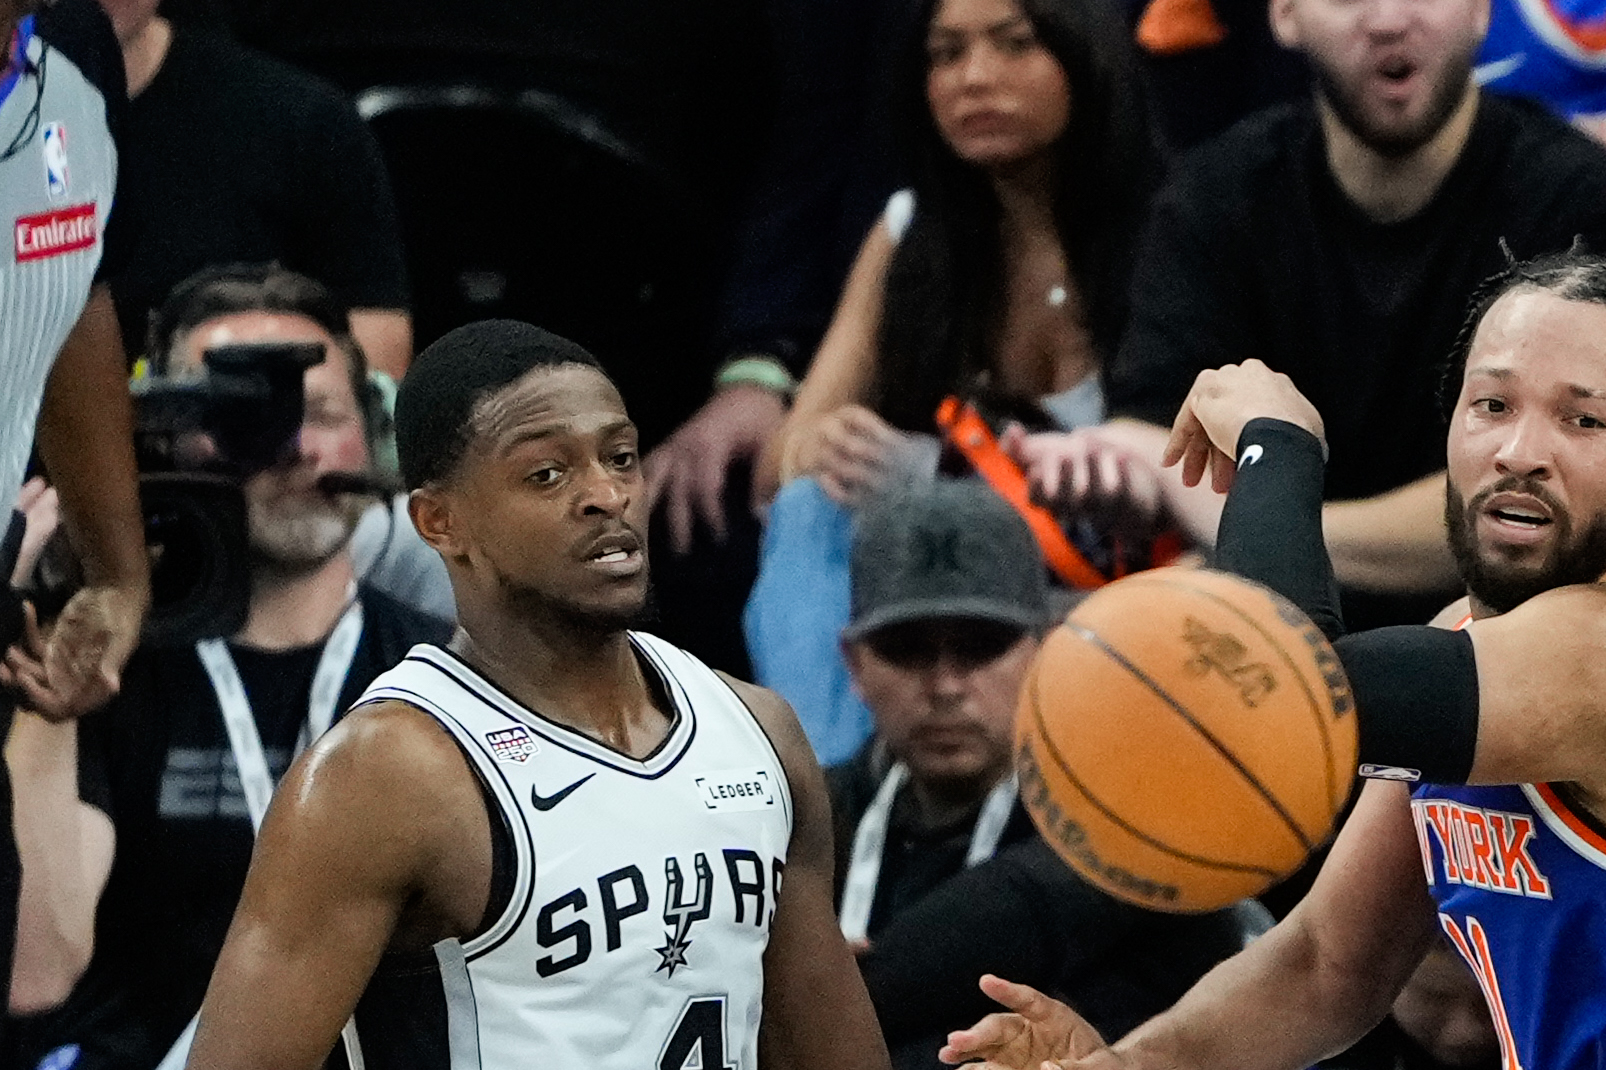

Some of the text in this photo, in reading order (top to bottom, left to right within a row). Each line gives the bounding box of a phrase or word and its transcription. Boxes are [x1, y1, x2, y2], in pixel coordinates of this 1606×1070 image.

[487, 729, 527, 744] USA
[496, 743, 538, 760] 250
[708, 781, 764, 799] LEDGER
[1424, 800, 1553, 900] YORK
